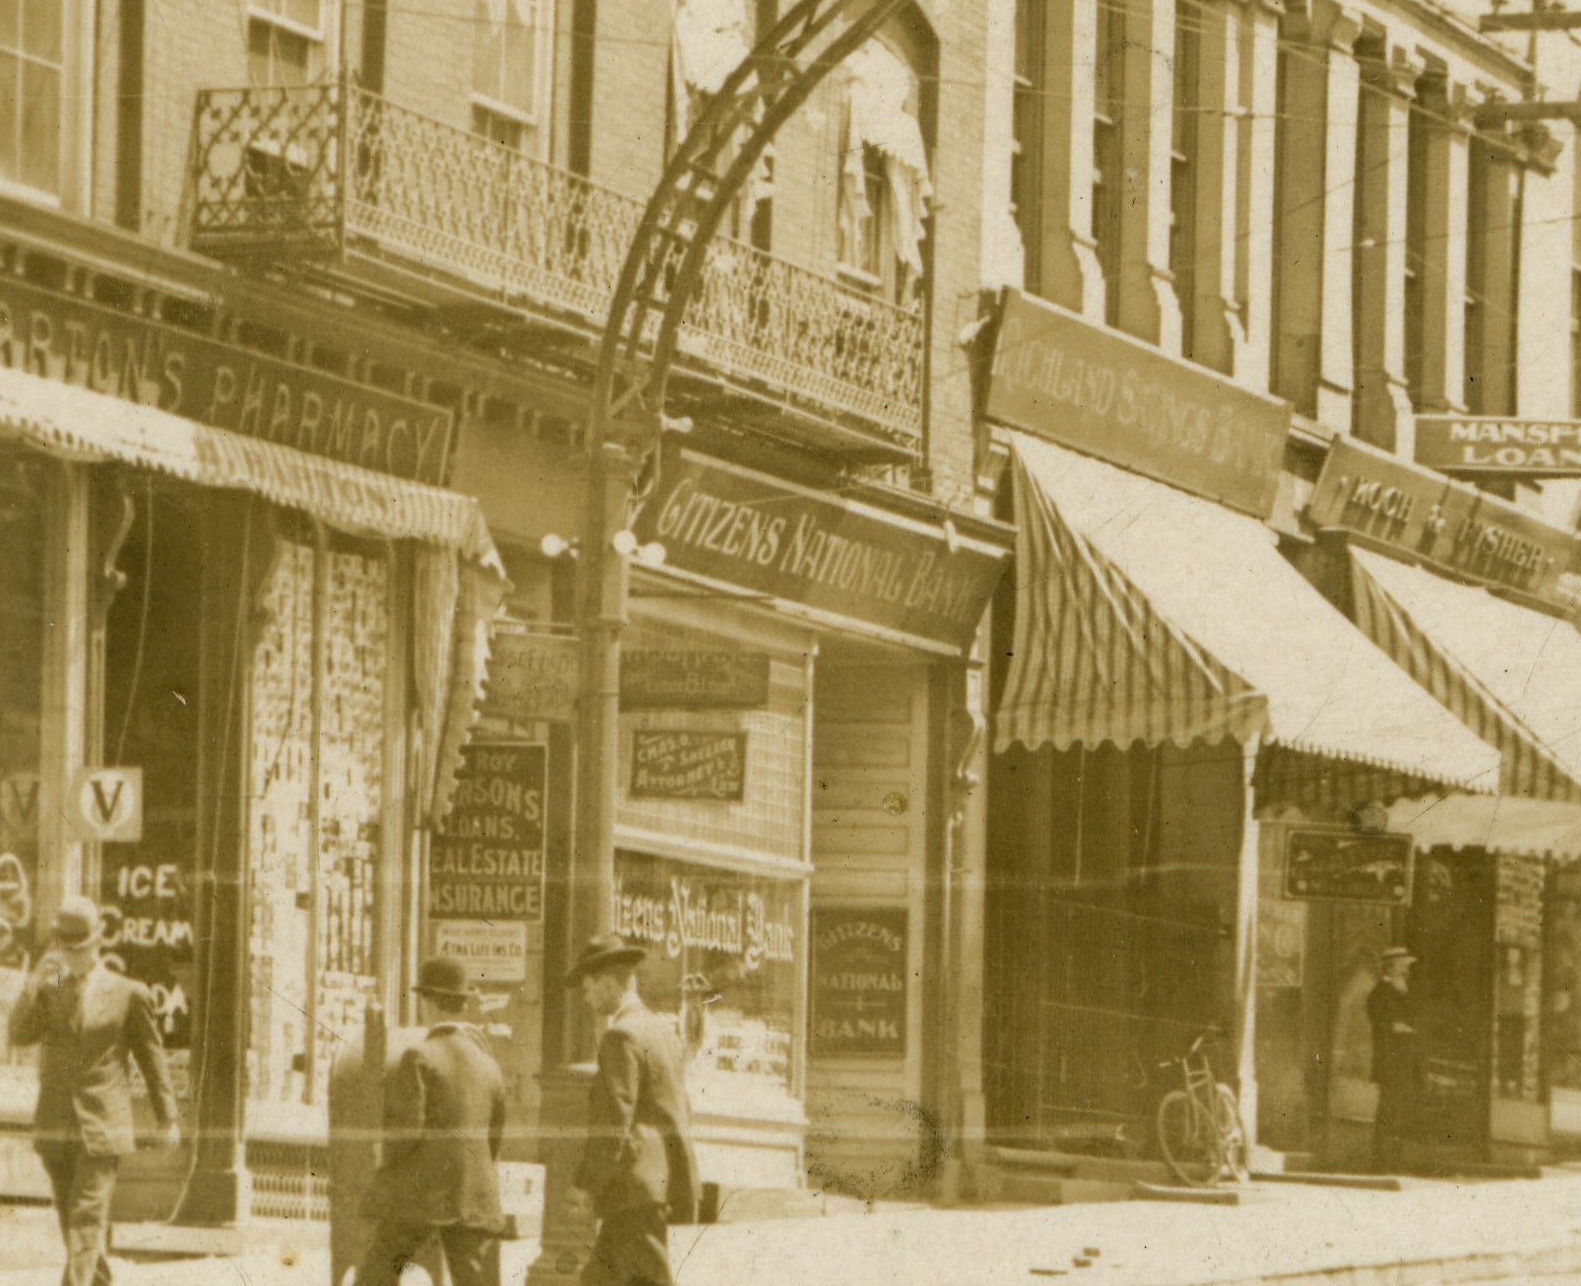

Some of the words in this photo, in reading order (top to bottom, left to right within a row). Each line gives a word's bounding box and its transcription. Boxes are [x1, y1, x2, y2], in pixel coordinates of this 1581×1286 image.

[209, 363, 441, 482] PHARMACY
[656, 478, 786, 567] CITIZENS
[780, 511, 909, 604] NATIONAL
[430, 846, 471, 875] EAL
[117, 862, 180, 900] ICE
[429, 882, 540, 914] NSURANCE
[96, 906, 195, 949] CREAM
[666, 876, 742, 959] National
[744, 893, 795, 971] Bank
[816, 920, 903, 954] CITIZENS
[817, 971, 904, 992] NATIONAL
[817, 1018, 901, 1040] BANK
